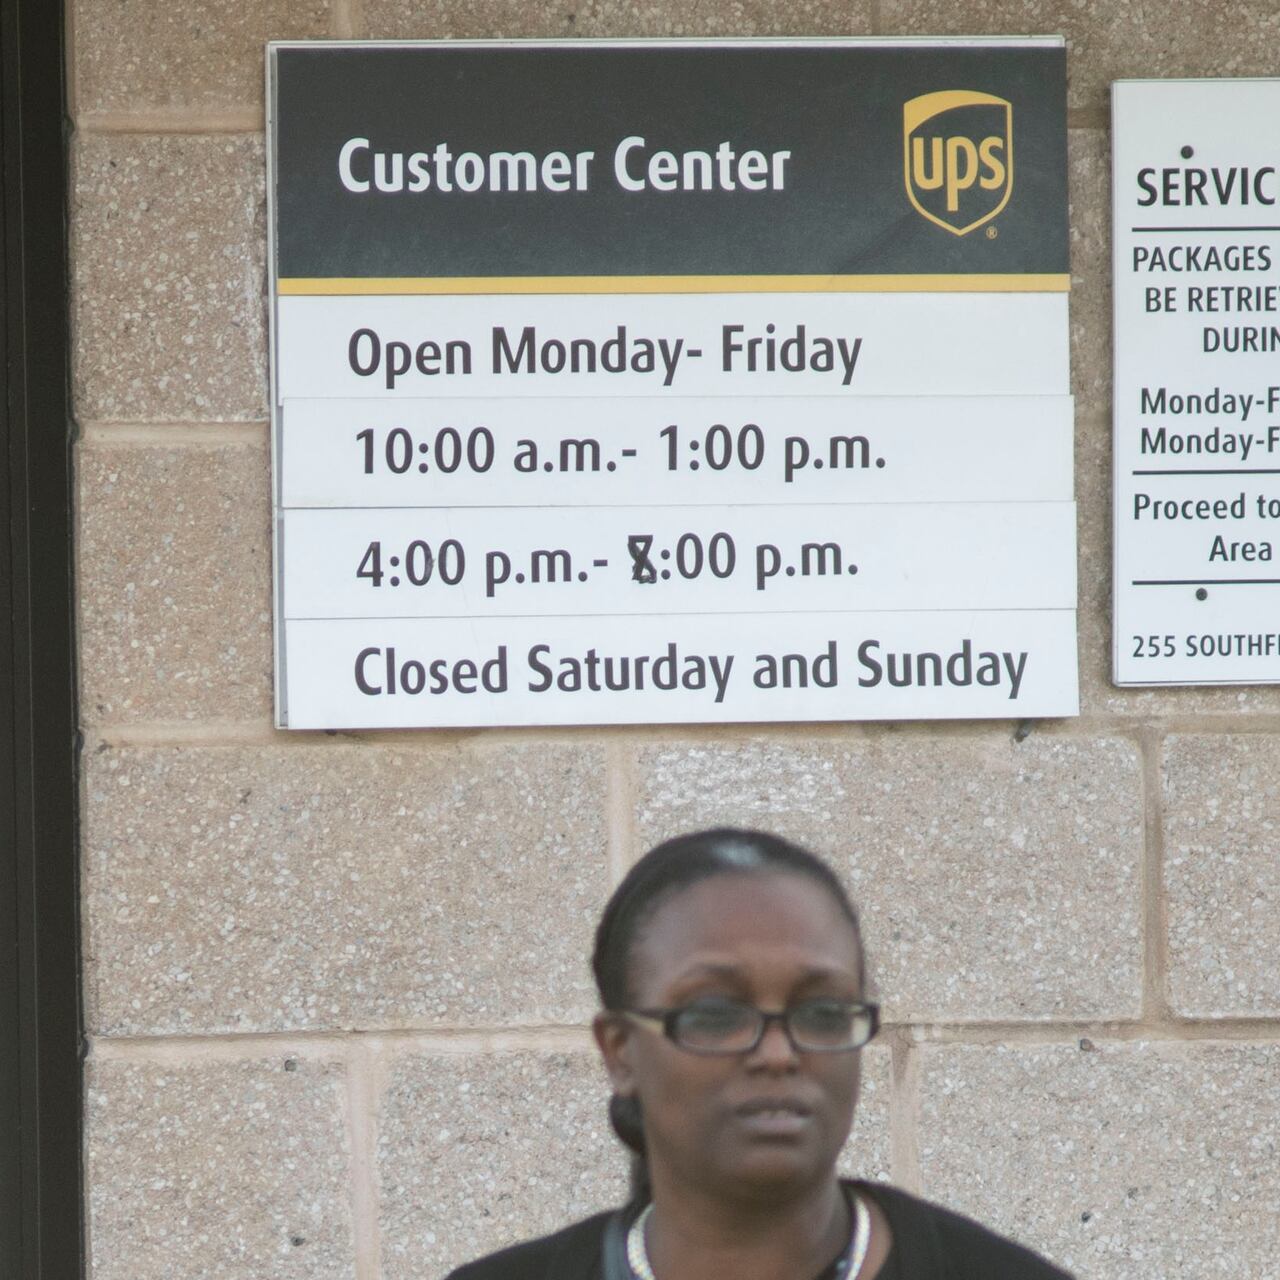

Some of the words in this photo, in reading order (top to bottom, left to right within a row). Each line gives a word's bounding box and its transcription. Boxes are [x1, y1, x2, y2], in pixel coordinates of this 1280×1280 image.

[339, 138, 594, 192] Customer
[615, 137, 791, 191] Center
[1133, 246, 1271, 272] PACKAGES
[1146, 287, 1176, 312] BE
[349, 329, 471, 389] Open
[723, 324, 862, 385] Friday
[357, 427, 494, 474] 10:00
[660, 424, 764, 470] 1:00
[785, 436, 885, 482] p.m.
[1134, 493, 1245, 519] Proceed
[357, 539, 465, 587] 4:00
[757, 543, 857, 590] p.m.
[1209, 536, 1271, 561] Area
[1133, 635, 1176, 657] 255
[355, 645, 507, 695] Closed
[528, 643, 734, 703] Saturday
[754, 641, 837, 688] and
[858, 640, 1027, 699] Sunday
